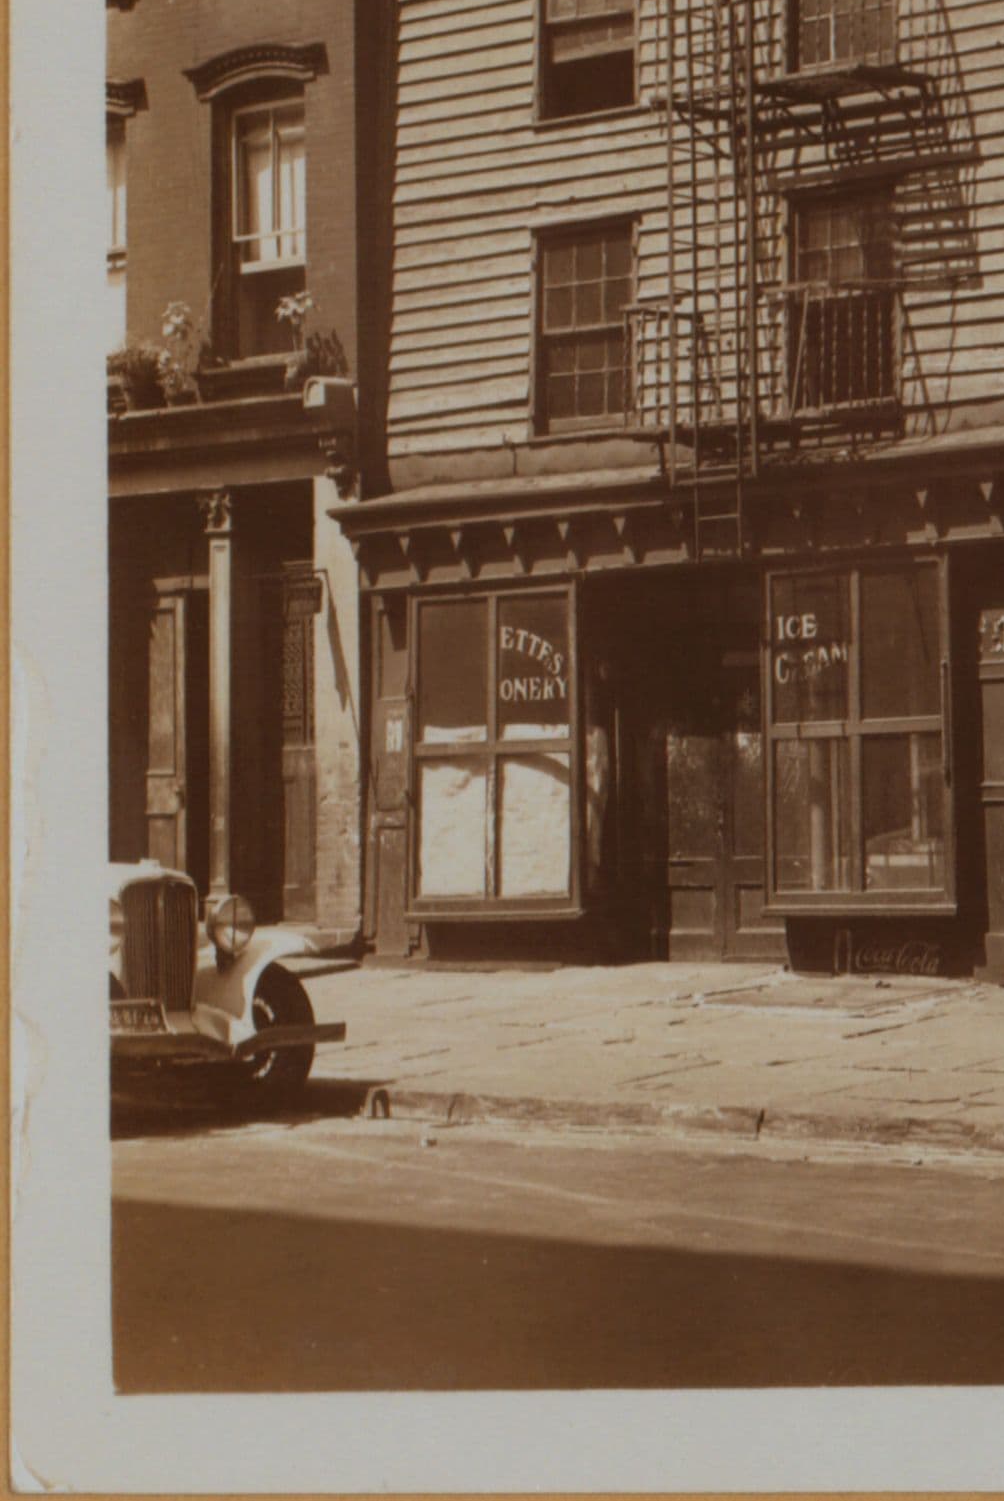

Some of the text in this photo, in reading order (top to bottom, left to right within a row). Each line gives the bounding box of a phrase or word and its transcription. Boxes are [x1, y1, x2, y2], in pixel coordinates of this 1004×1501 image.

[776, 612, 818, 641] ICE
[774, 640, 848, 684] CEAM
[499, 675, 569, 702] ONERY
